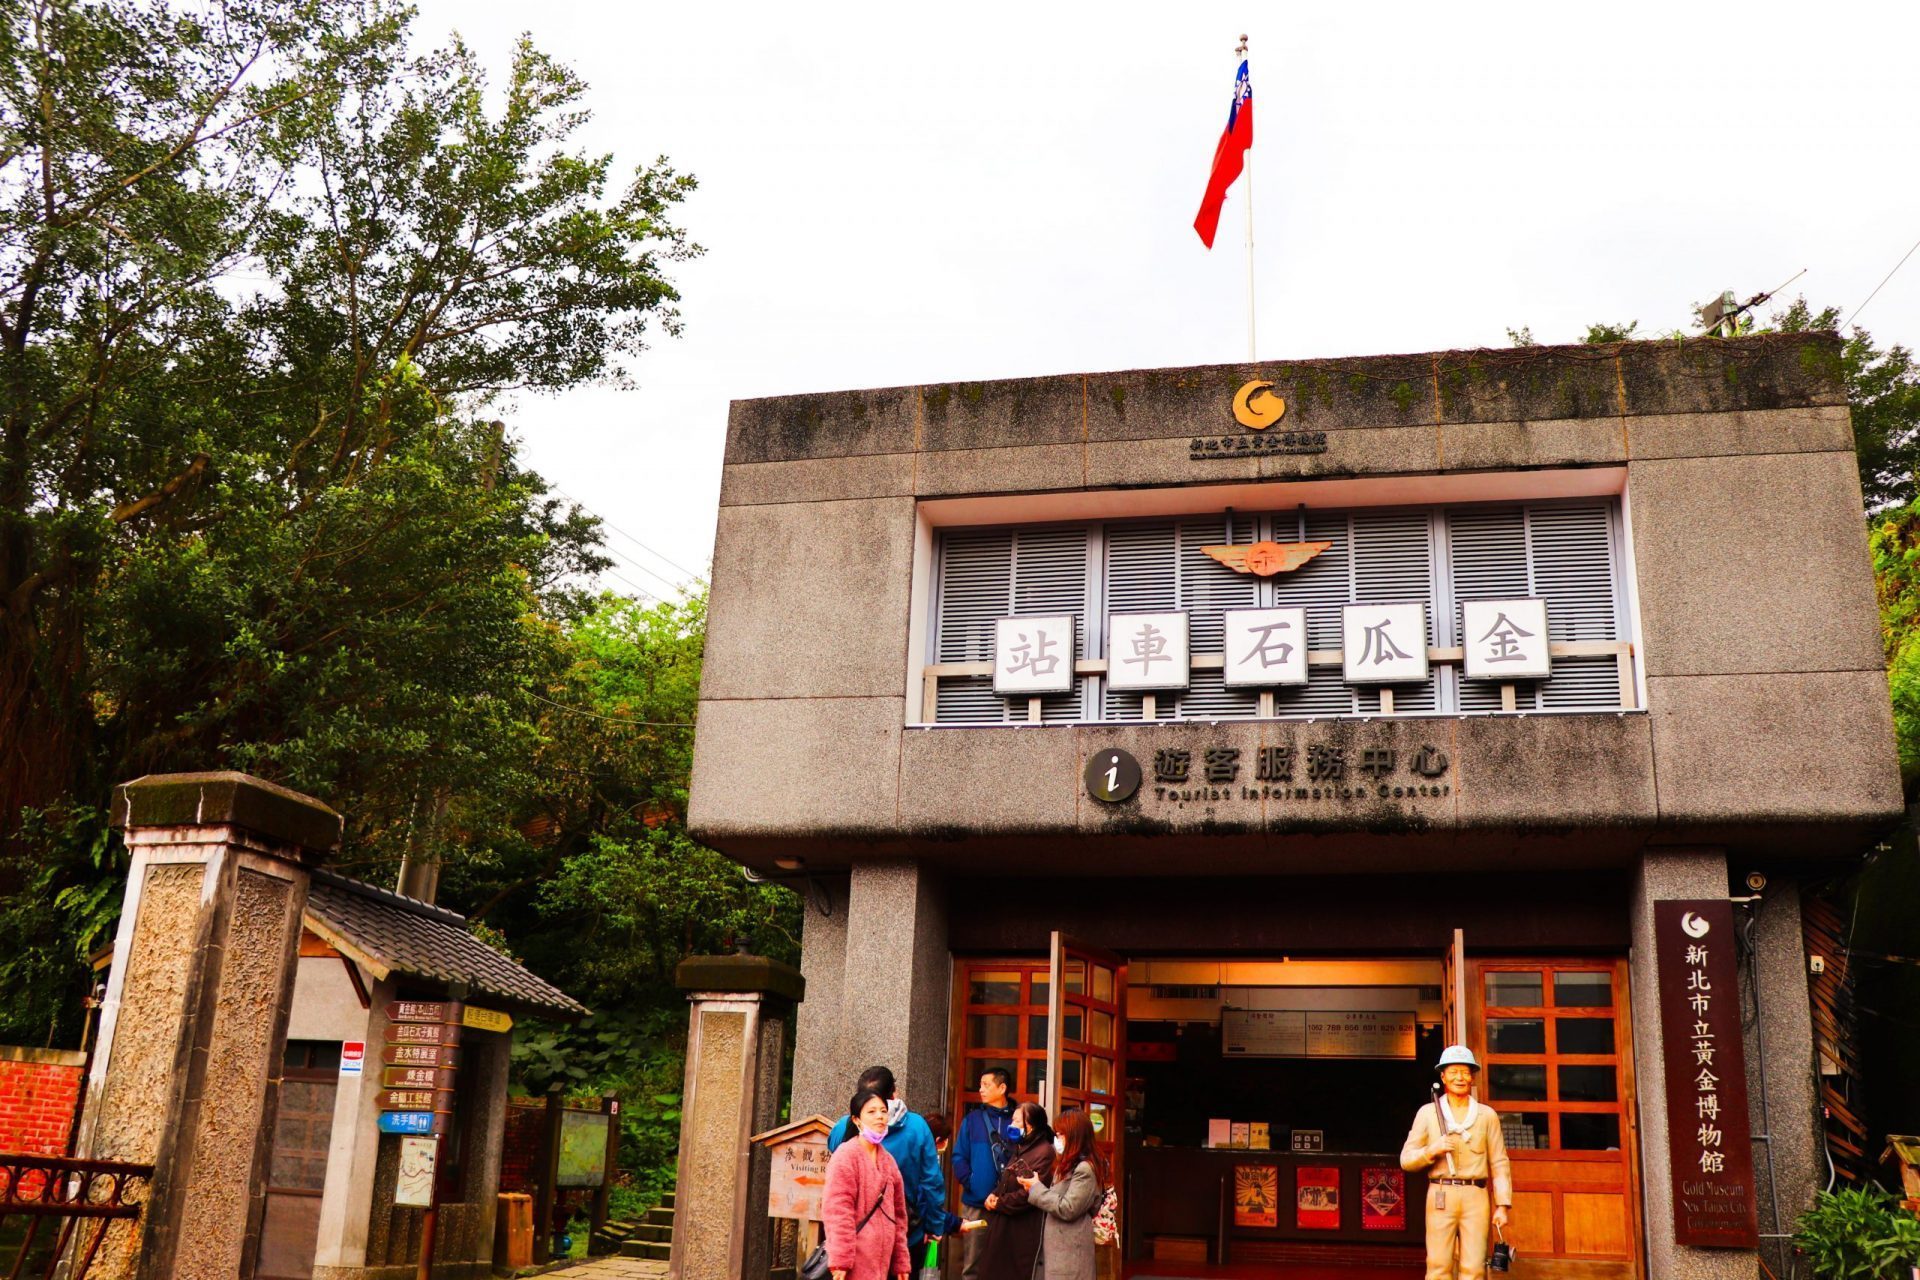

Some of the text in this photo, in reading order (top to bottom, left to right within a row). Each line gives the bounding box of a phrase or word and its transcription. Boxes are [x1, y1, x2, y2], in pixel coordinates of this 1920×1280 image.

[1154, 744, 1449, 783] 遊客服務中心
[1154, 783, 1450, 801] Tourist Information Center
[395, 1046, 438, 1060] 金水特展室
[1685, 944, 1725, 1174] 新北市立黃金博物館
[391, 1114, 418, 1126] 洗手間
[791, 1163, 819, 1174] Visiting
[1682, 1180, 1745, 1197] Gold Museum
